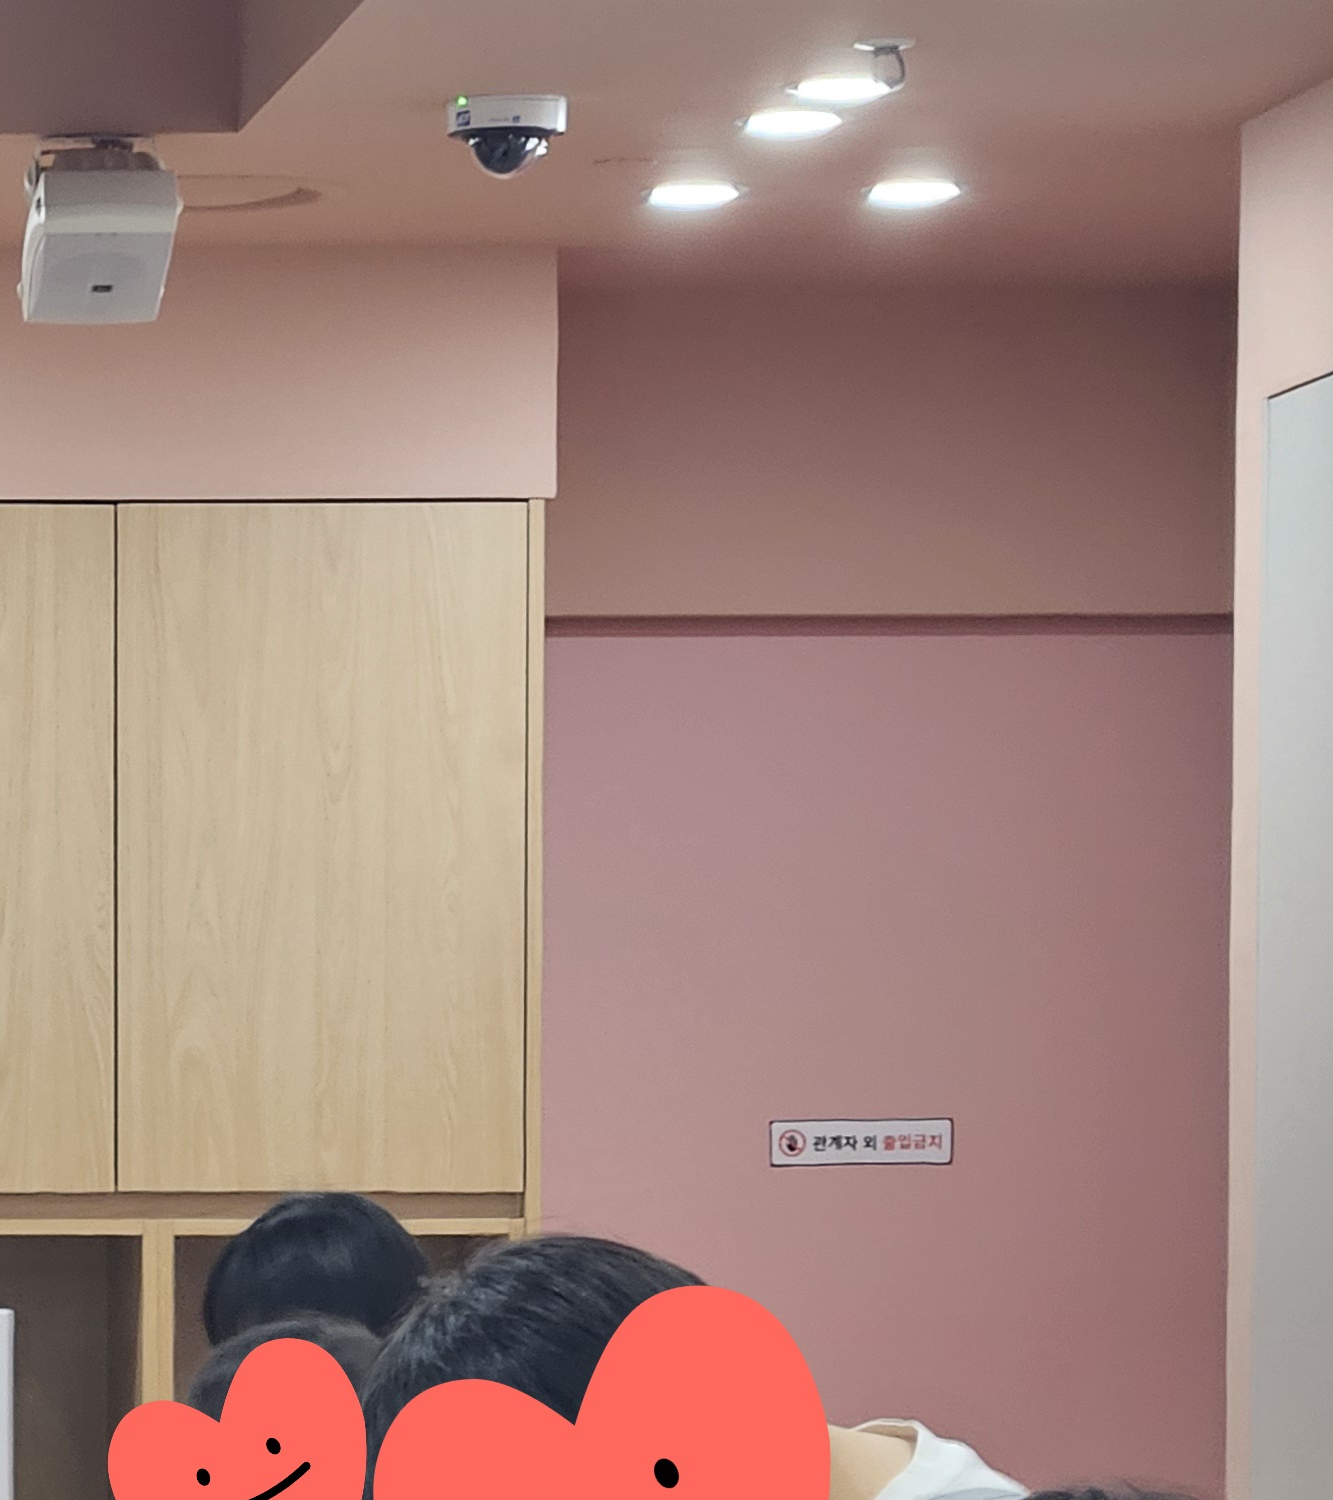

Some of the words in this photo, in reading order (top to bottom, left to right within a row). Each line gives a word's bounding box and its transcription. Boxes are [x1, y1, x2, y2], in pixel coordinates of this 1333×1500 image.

[813, 1134, 858, 1152] 관계자
[863, 1134, 877, 1151] 외
[883, 1132, 942, 1151] 출입금지
